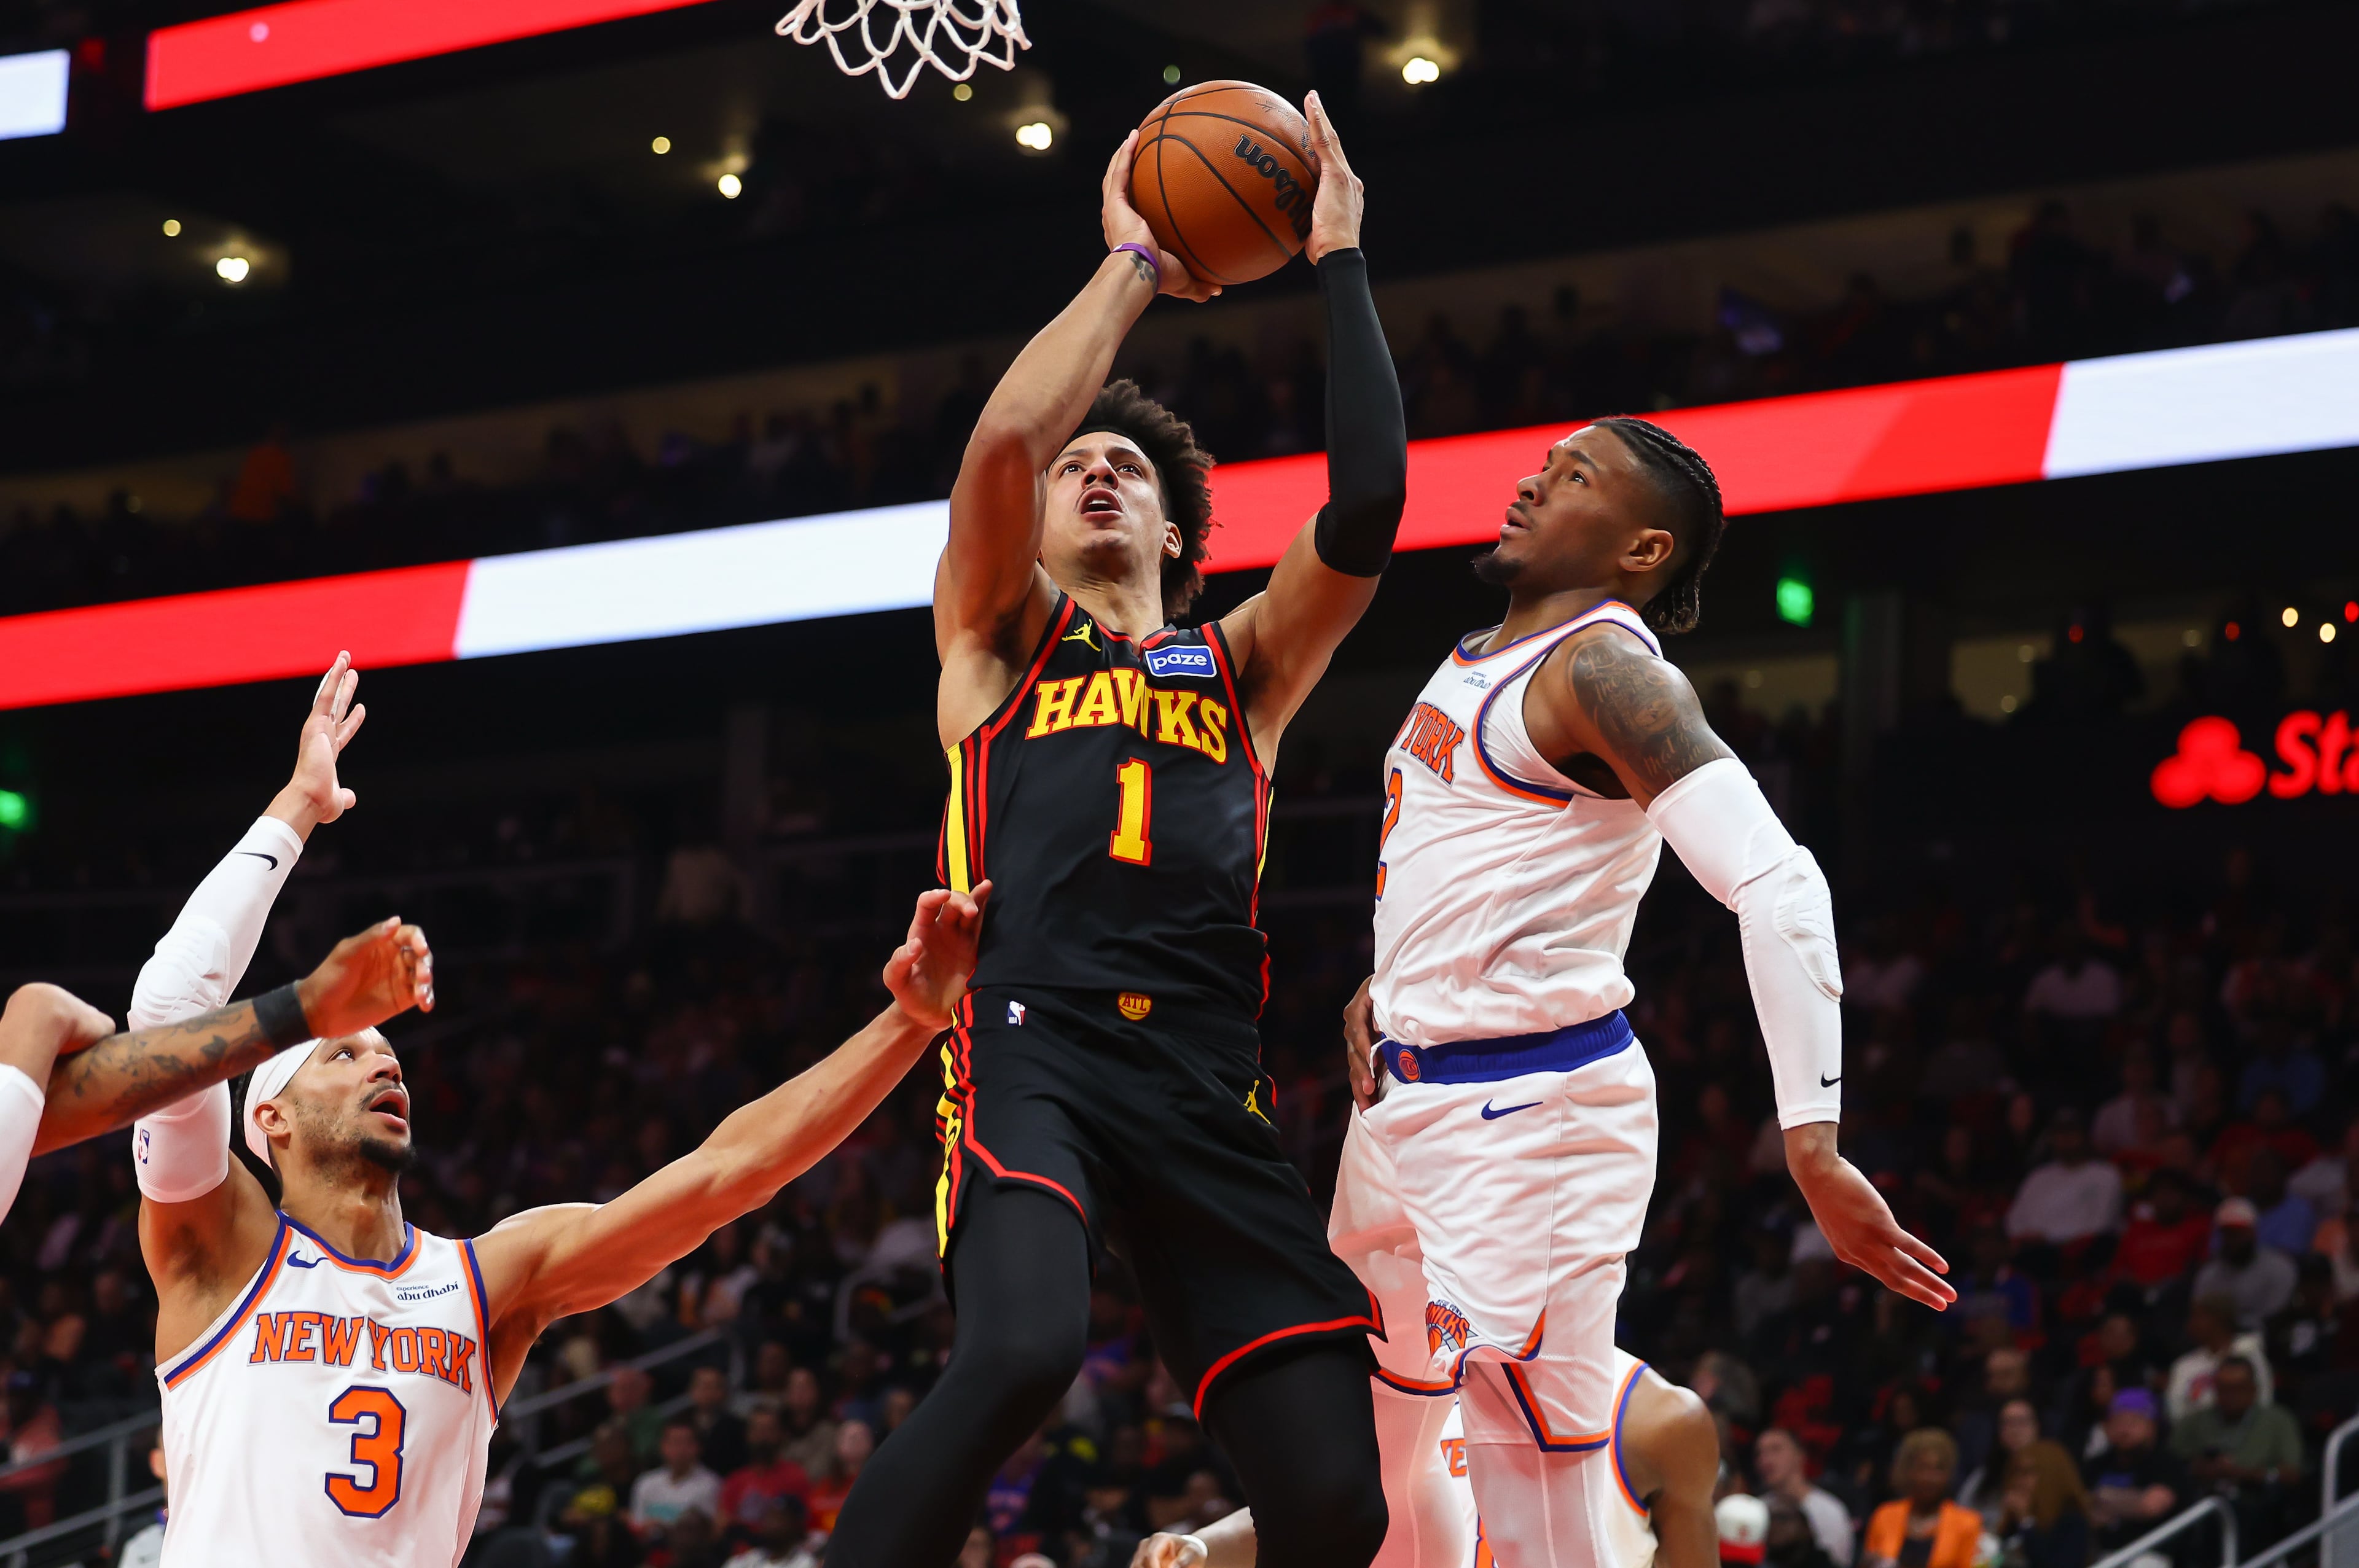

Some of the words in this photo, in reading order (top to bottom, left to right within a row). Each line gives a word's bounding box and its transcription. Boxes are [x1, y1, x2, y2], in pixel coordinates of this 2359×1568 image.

[1152, 653, 1207, 671] paze
[1025, 668, 1229, 764] HAWKS
[1399, 701, 1467, 789] YORK
[1109, 757, 1152, 867] 1
[1122, 993, 1148, 1012] ATL
[397, 1292, 421, 1301] abu
[423, 1281, 459, 1299] dhabi
[247, 1311, 365, 1368] NEW
[367, 1316, 477, 1397] YORK
[324, 1385, 407, 1519] 3
